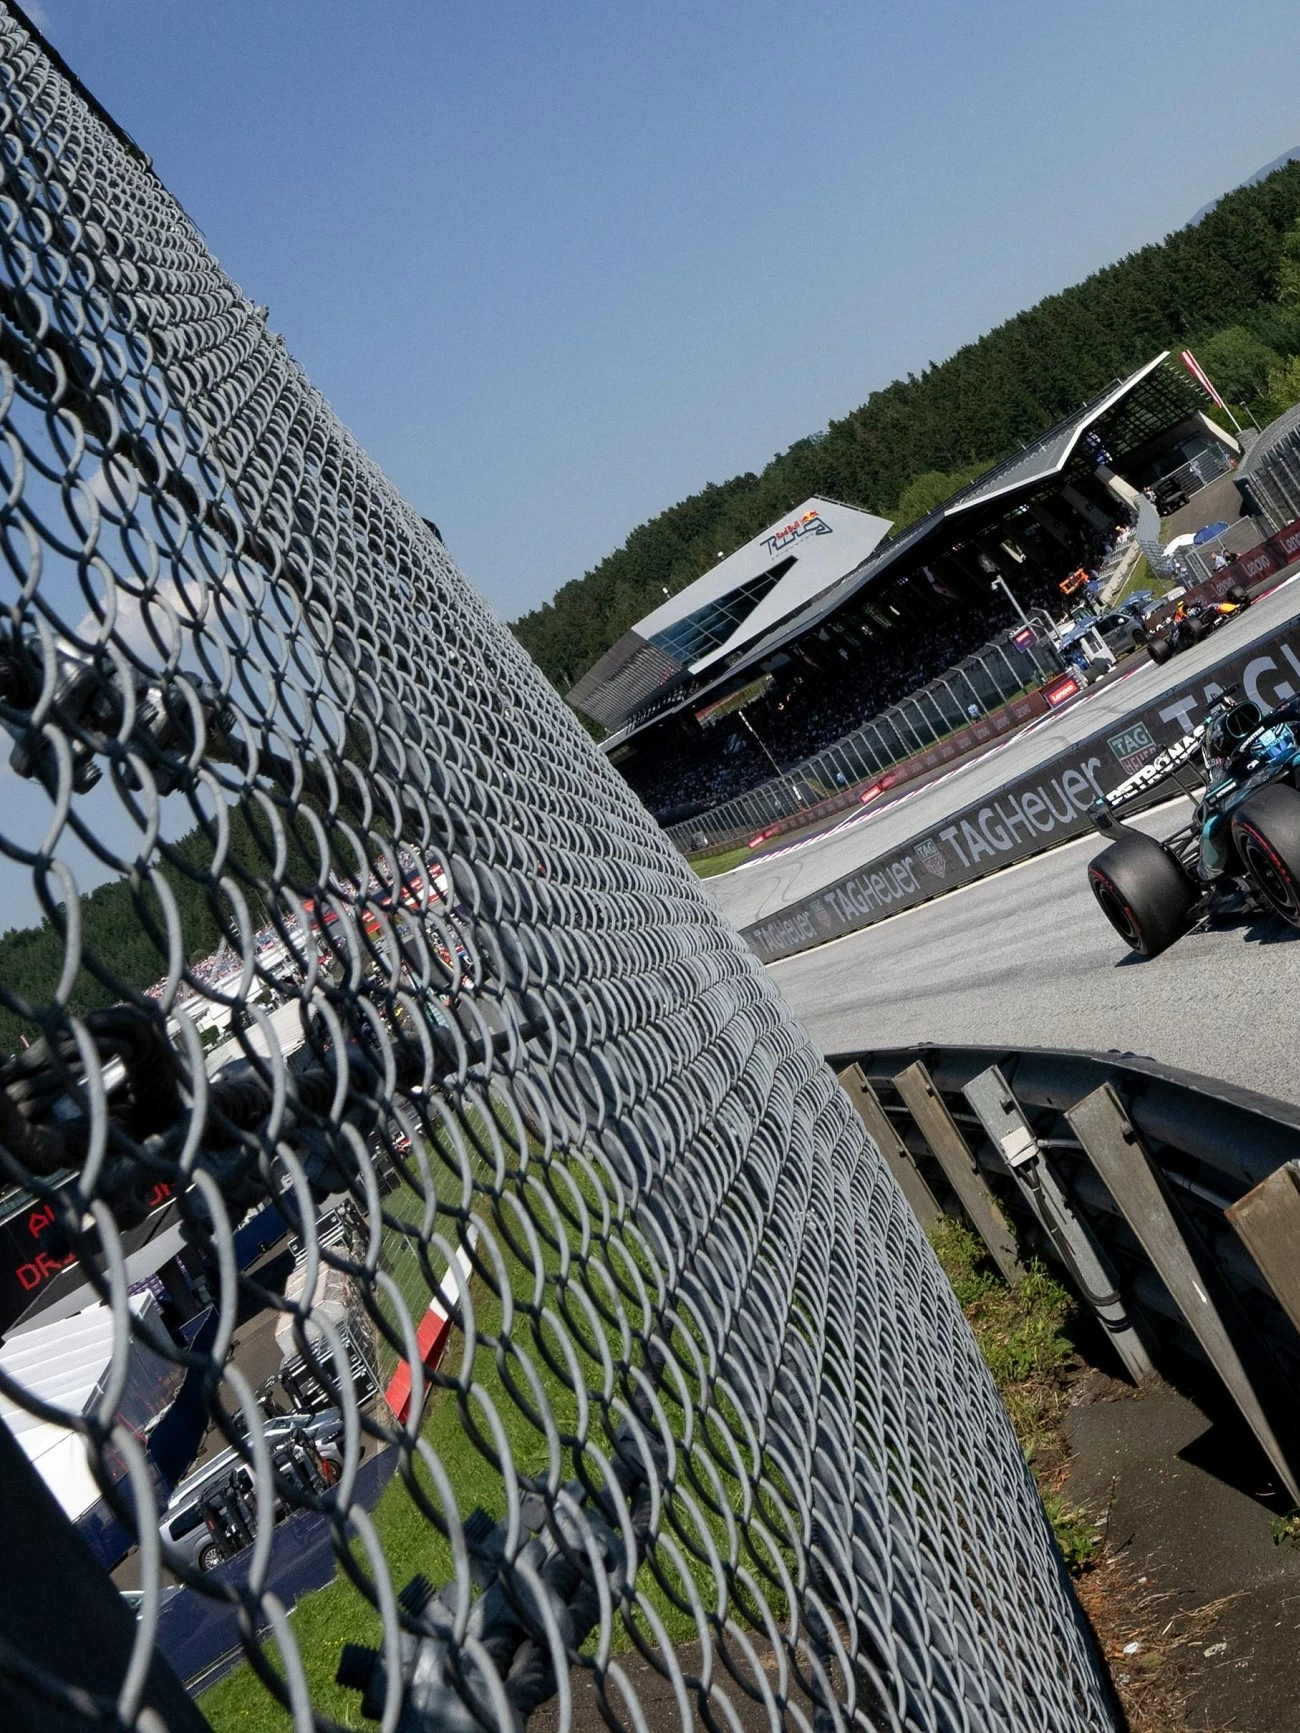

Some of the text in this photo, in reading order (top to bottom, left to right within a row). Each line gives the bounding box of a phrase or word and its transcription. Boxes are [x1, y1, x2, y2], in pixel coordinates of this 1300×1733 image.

[1241, 553, 1271, 578] Lenovo
[1052, 684, 1075, 702] Lenovo
[1112, 727, 1149, 756] TAG
[918, 841, 939, 858] TAG
